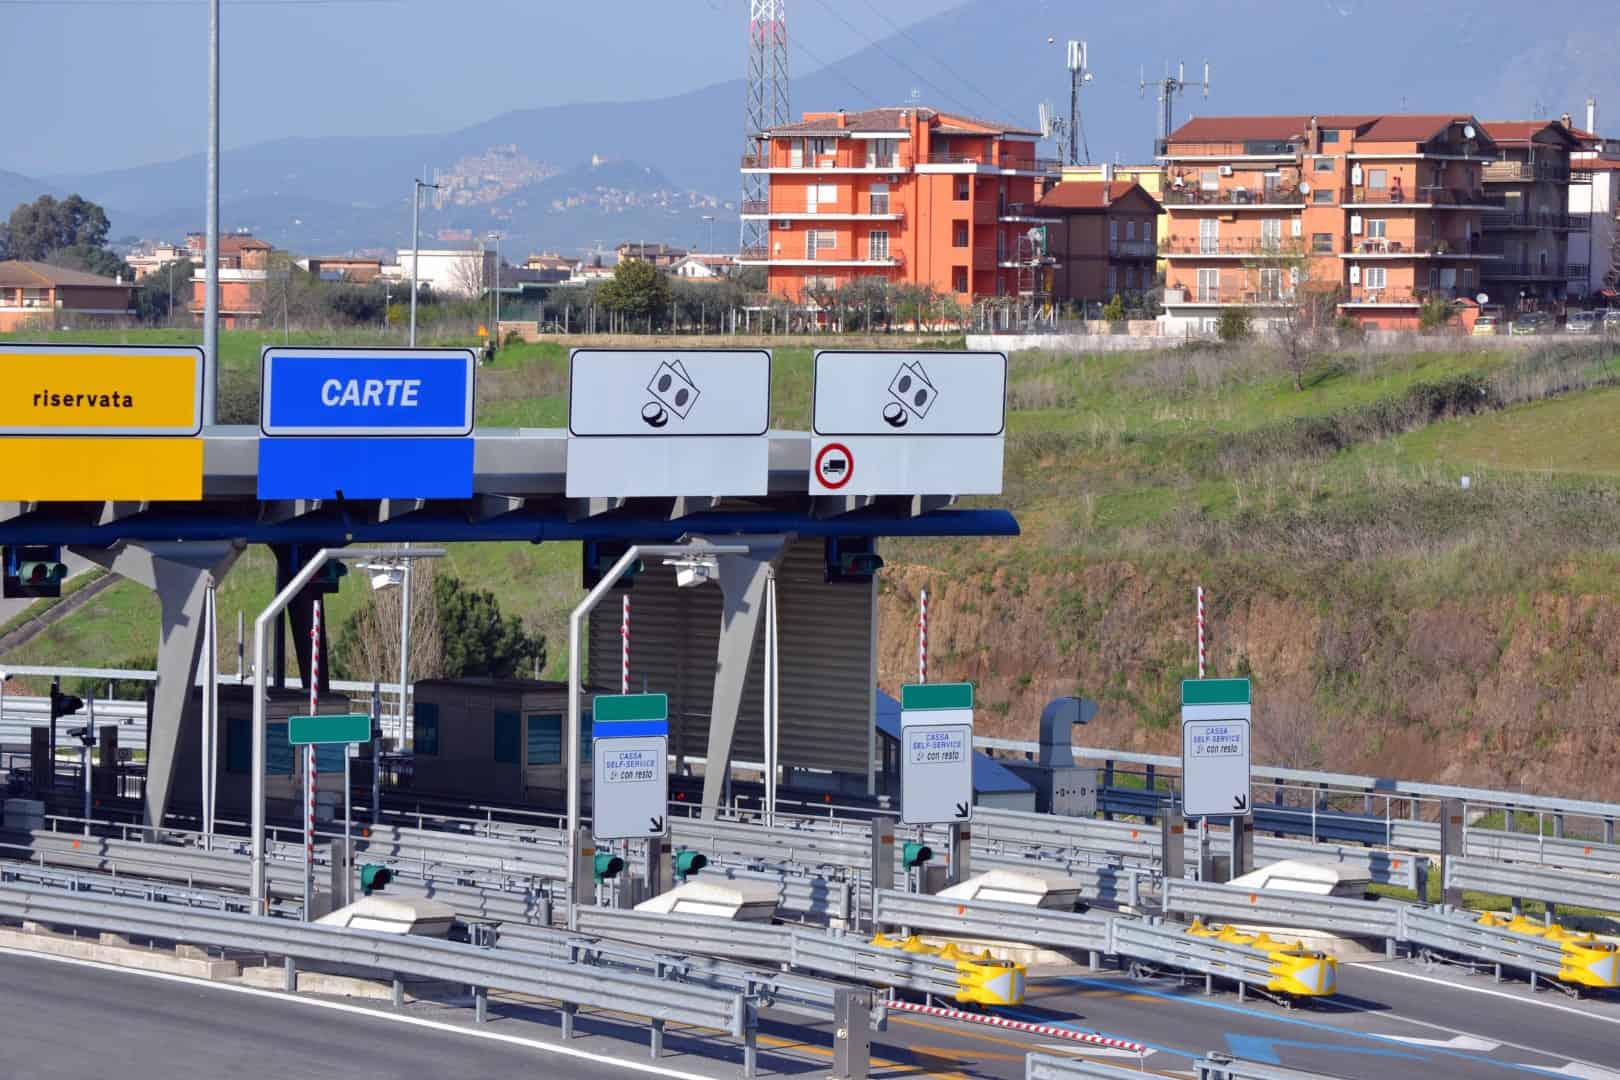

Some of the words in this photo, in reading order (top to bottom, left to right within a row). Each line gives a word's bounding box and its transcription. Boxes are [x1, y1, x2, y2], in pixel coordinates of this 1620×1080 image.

[33, 389, 133, 407] riservata
[321, 379, 421, 406] CARTE
[927, 752, 940, 761] con
